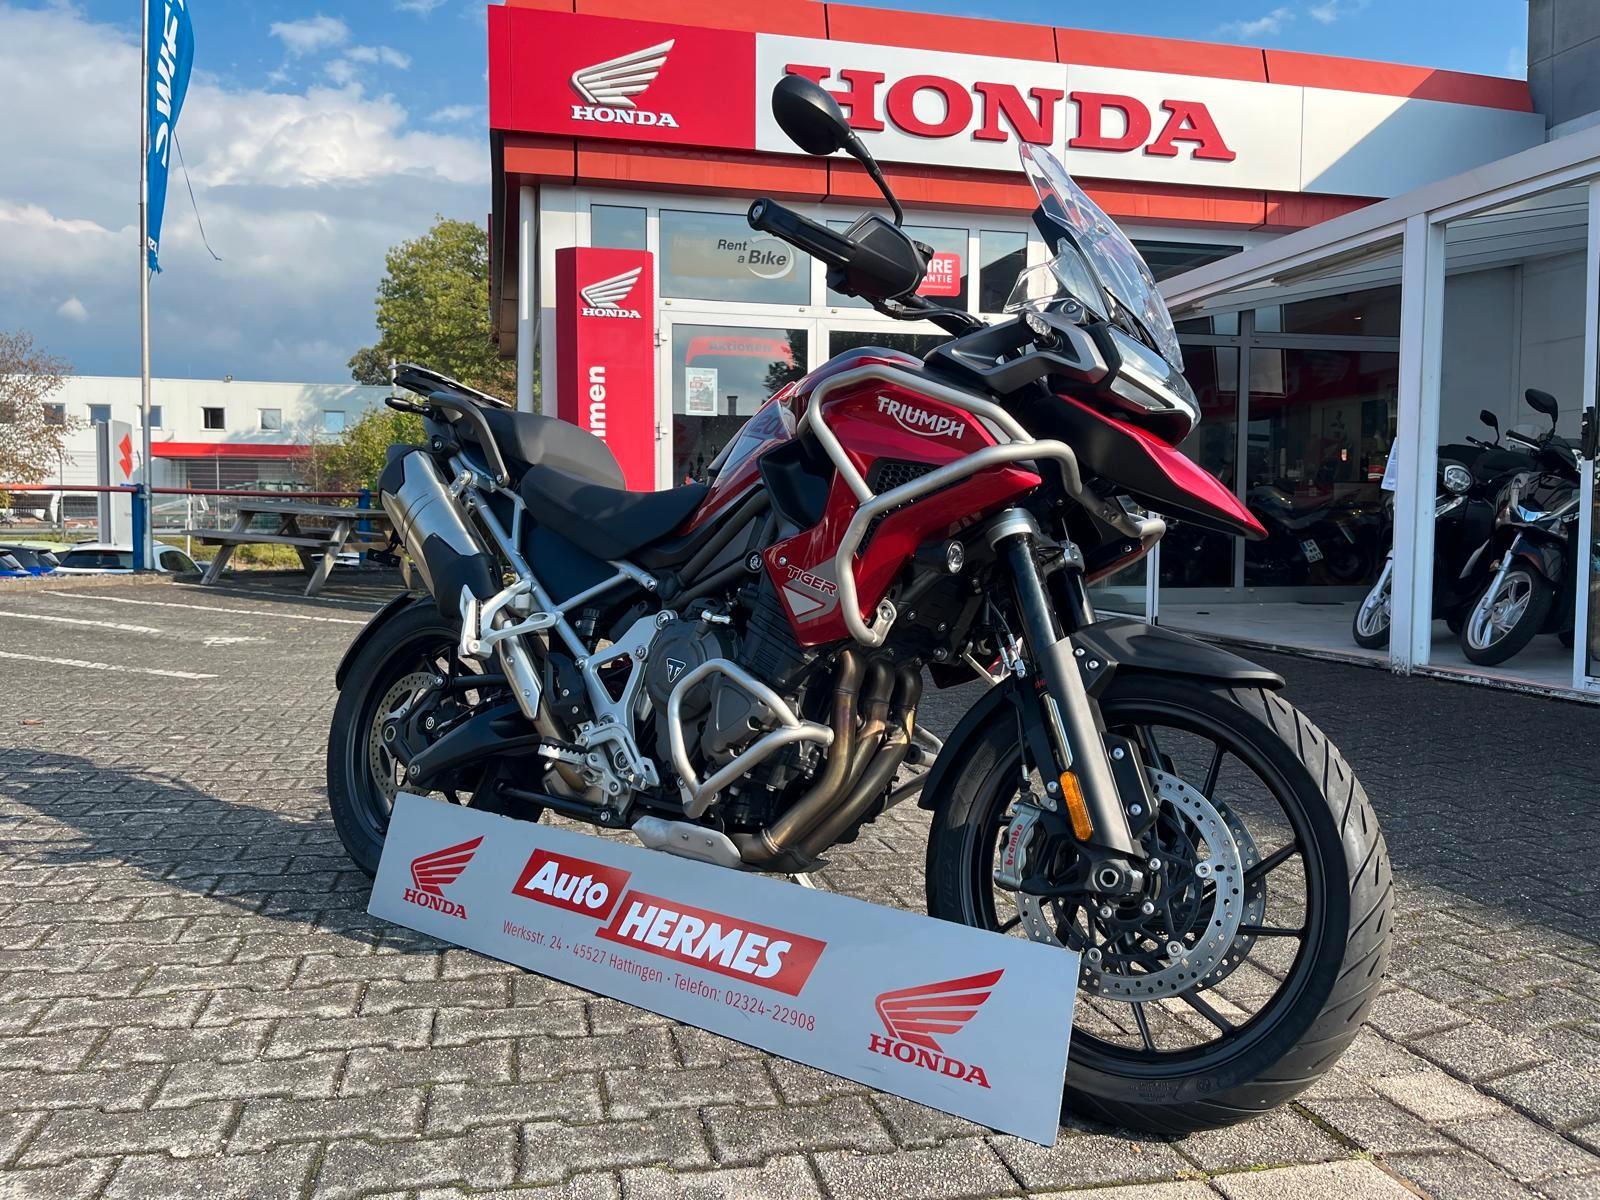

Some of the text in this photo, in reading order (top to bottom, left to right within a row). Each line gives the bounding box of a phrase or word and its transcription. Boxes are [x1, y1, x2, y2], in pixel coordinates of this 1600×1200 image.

[571, 105, 680, 128] HONDA
[785, 64, 1237, 162] HONDA
[717, 239, 748, 251] Rent
[737, 250, 787, 266] a Bike
[922, 275, 953, 284] ANTIE
[581, 307, 642, 319] HONDA
[589, 365, 606, 443] men
[877, 395, 965, 440] TRIUMPH
[787, 564, 838, 597] TIGER
[1004, 823, 1024, 866] brembo
[403, 887, 468, 920] HONDA
[523, 860, 609, 909] Auto
[616, 900, 793, 979] HERMES
[502, 919, 816, 1032] Werksstr. 24 45527 Hattingen Telefon: 02324-22908
[867, 1033, 992, 1090] HONDA
